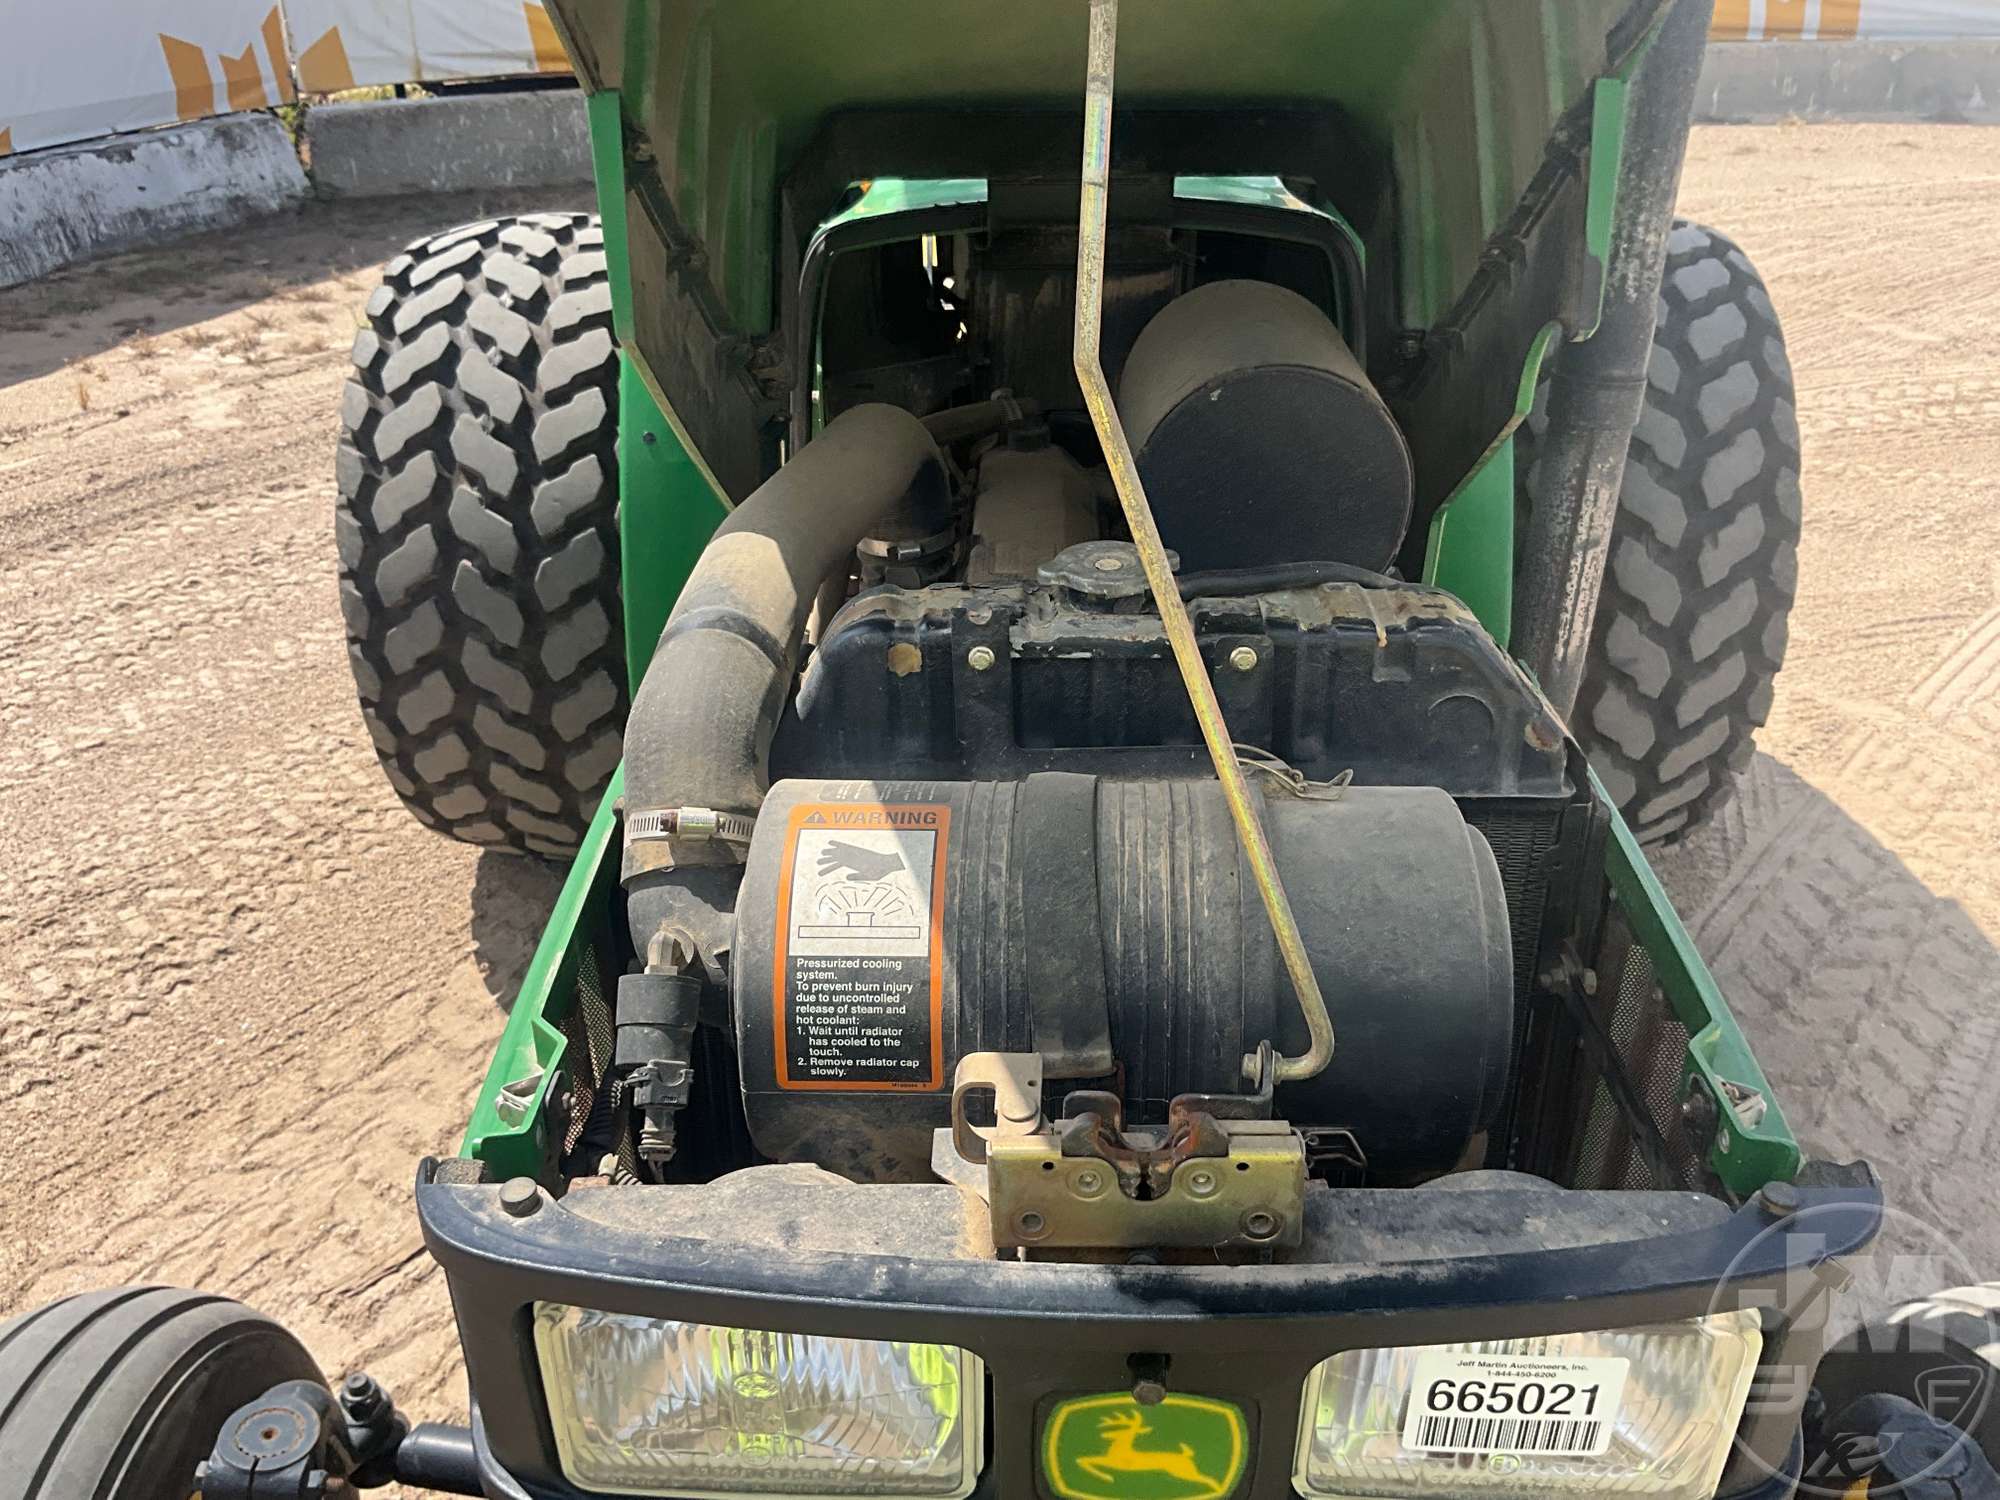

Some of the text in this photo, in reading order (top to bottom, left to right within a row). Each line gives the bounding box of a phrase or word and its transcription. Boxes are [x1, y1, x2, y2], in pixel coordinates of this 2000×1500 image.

[833, 812, 937, 825] WARNING
[796, 958, 902, 970] Pressurized cooling
[796, 970, 838, 980] system.
[796, 982, 913, 993] To prevent burn injury
[796, 994, 900, 1003] due to uncontrolled
[796, 1004, 906, 1014] release of steam and
[796, 1015, 860, 1025] hot coolant:
[797, 1026, 902, 1036] 1. Wait until radiator
[809, 1037, 901, 1046] has cooled to the
[809, 1047, 842, 1056] touch.
[797, 1058, 920, 1068] 2. Remove radiator cap
[810, 1067, 847, 1077] slowly.
[1477, 1361, 1508, 1369] Martin
[1509, 1362, 1568, 1371] Auctioneers,
[1571, 1363, 1589, 1371] Inc.
[1487, 1370, 1557, 1378] 1-844-450-6200
[1426, 1379, 1600, 1415] 665021
